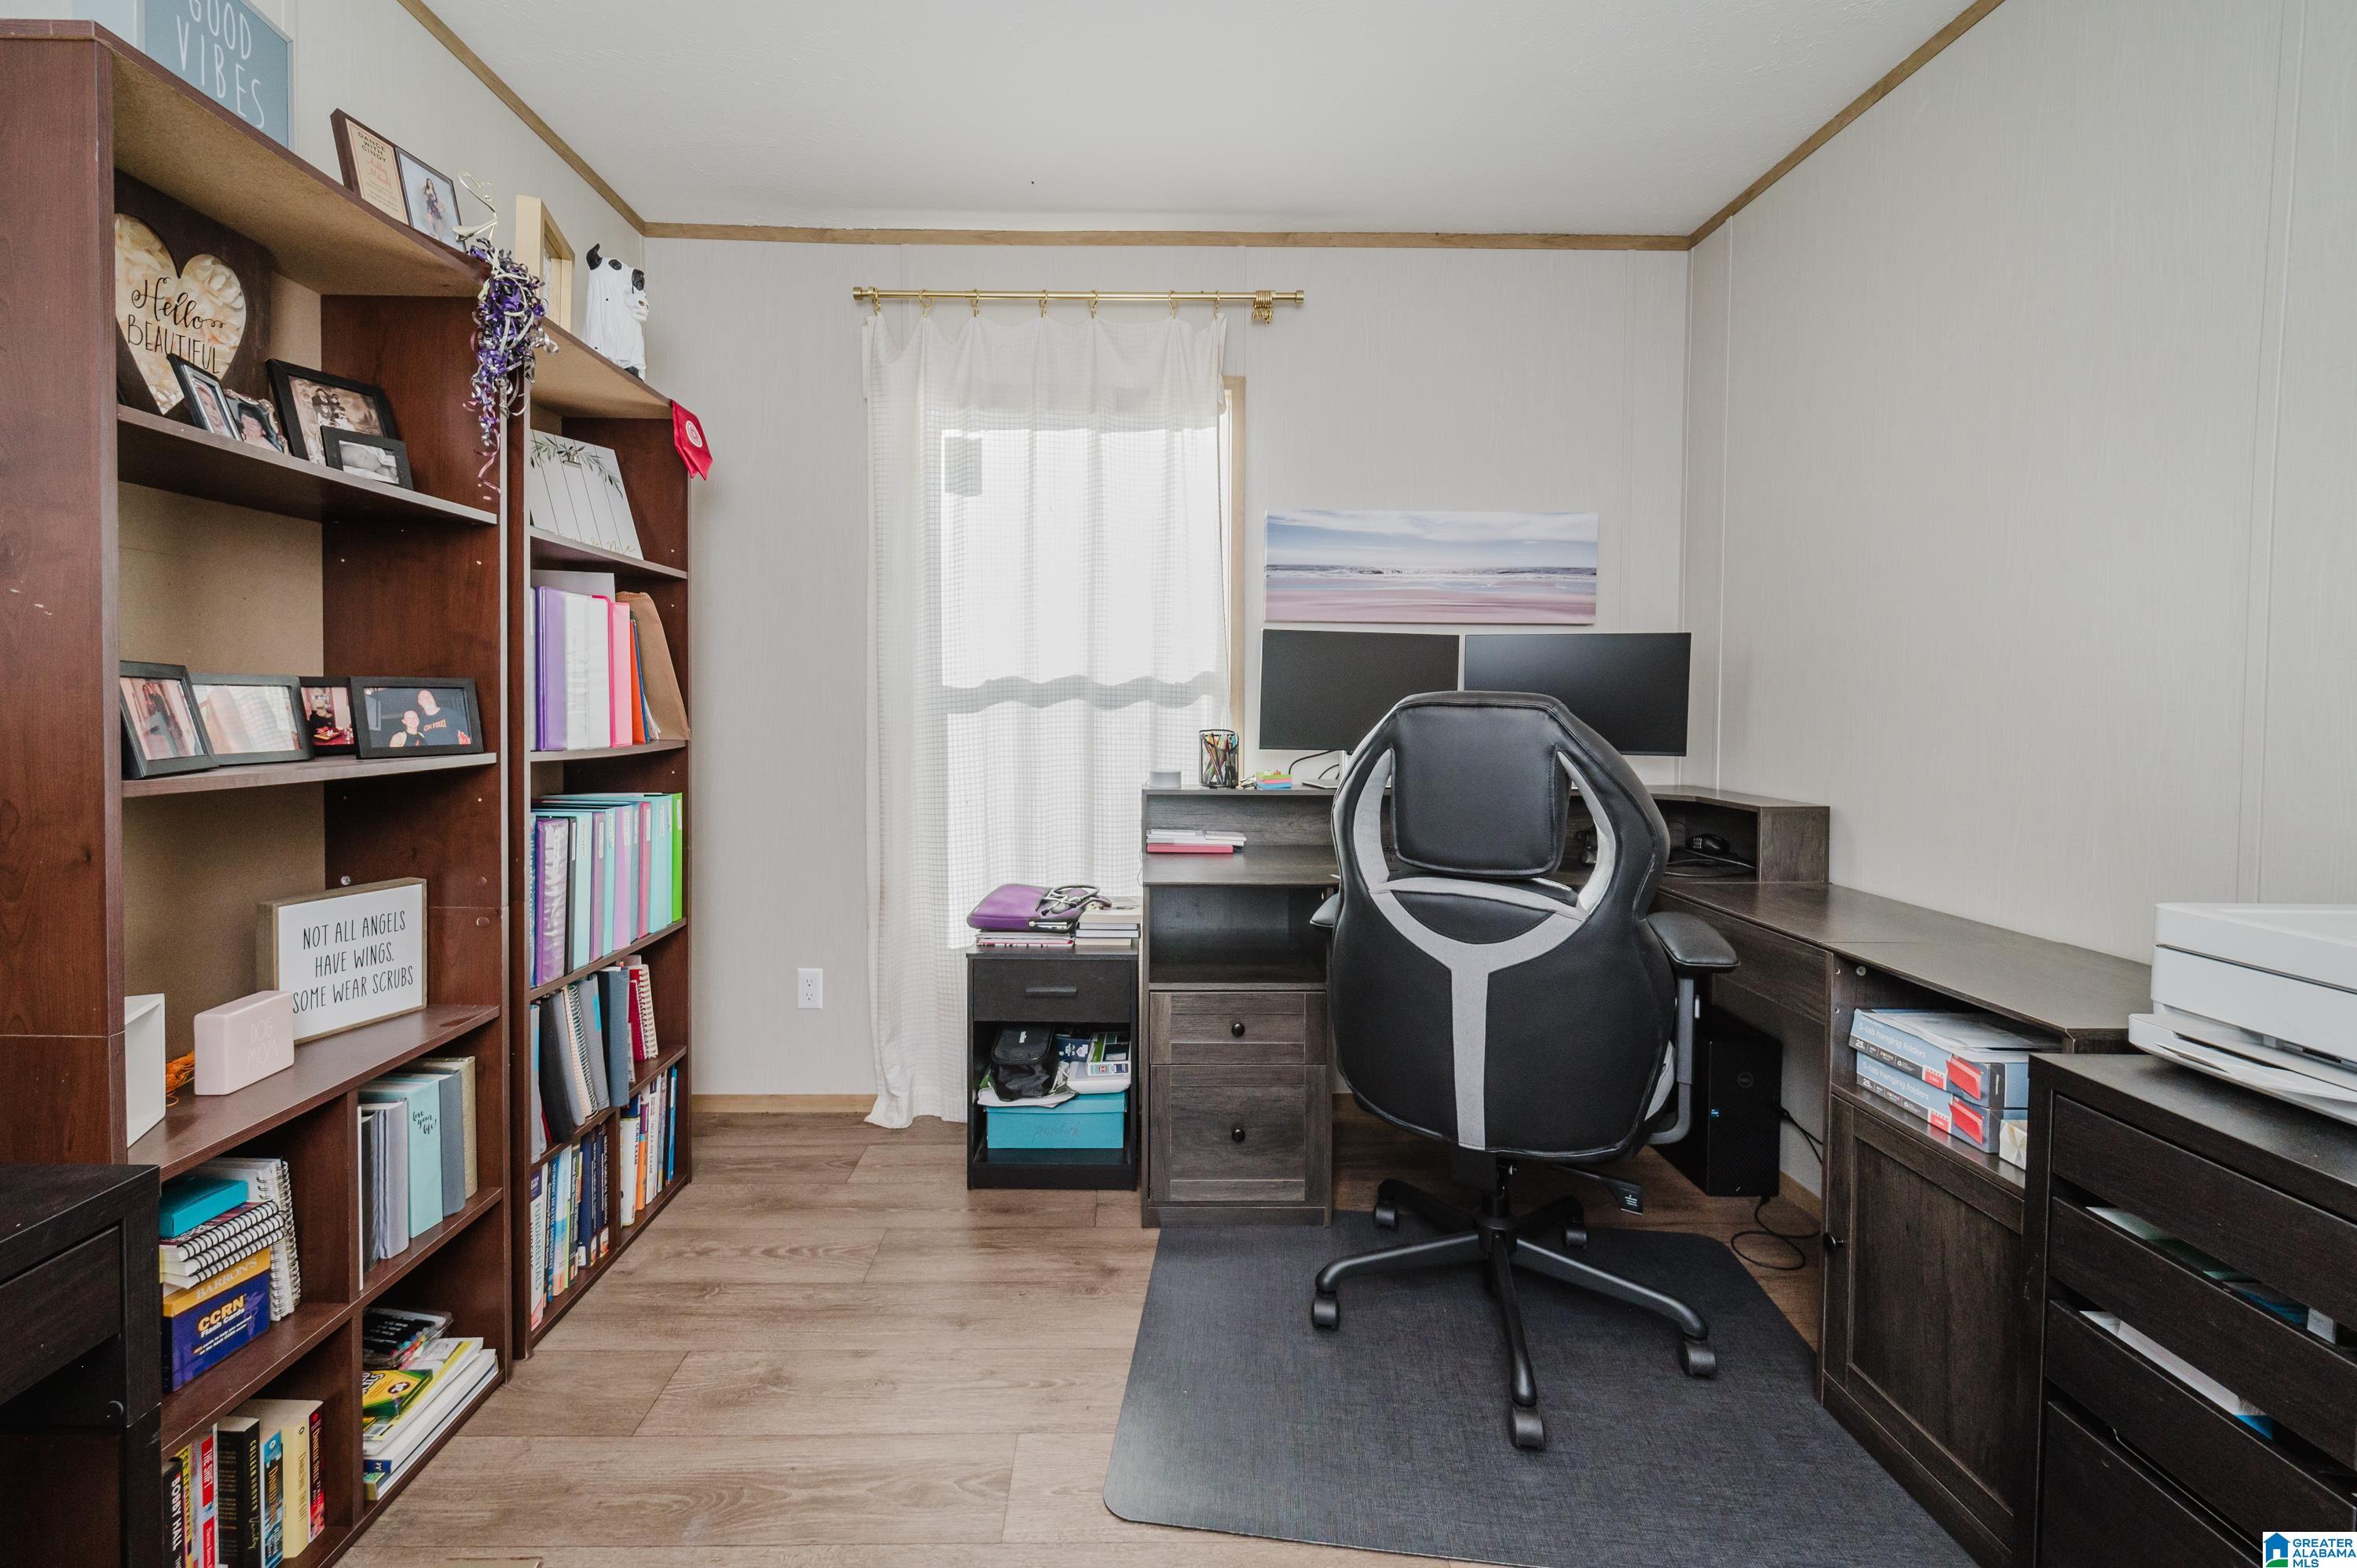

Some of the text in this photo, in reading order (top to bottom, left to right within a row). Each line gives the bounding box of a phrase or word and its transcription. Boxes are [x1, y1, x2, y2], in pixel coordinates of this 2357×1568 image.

[177, 13, 265, 128] VIBES
[358, 132, 386, 152] DANCE
[361, 145, 386, 162] CINDY
[364, 141, 383, 156] WITH
[131, 277, 225, 329] Hello
[128, 314, 220, 373] BEAUTIFUL
[303, 910, 405, 951] NOT ALL ANGELS
[315, 942, 394, 977] HAVE WINGS.
[293, 965, 413, 1013] SOME WEAR SCRUBS
[251, 1016, 273, 1044] DOG
[1859, 1023, 1875, 1036] 5-tab
[1876, 1031, 1901, 1049] hanging
[1903, 1041, 1926, 1058] folders
[247, 1037, 279, 1069] MOM
[1880, 1068, 1905, 1089] hanging
[1907, 1083, 1929, 1101] folders
[196, 1258, 258, 1299] BARRON'S
[198, 1294, 244, 1332] CCRN
[200, 1308, 245, 1338] Flash Cards
[249, 1439, 258, 1478] COLLEEN
[313, 1427, 321, 1463] DANIELLE
[203, 1447, 214, 1490] THE SHIFT
[268, 1464, 279, 1505] DANIELLE
[171, 1475, 181, 1518] BOBBY
[172, 1517, 182, 1552] HALL
[247, 1515, 260, 1551] Verity
